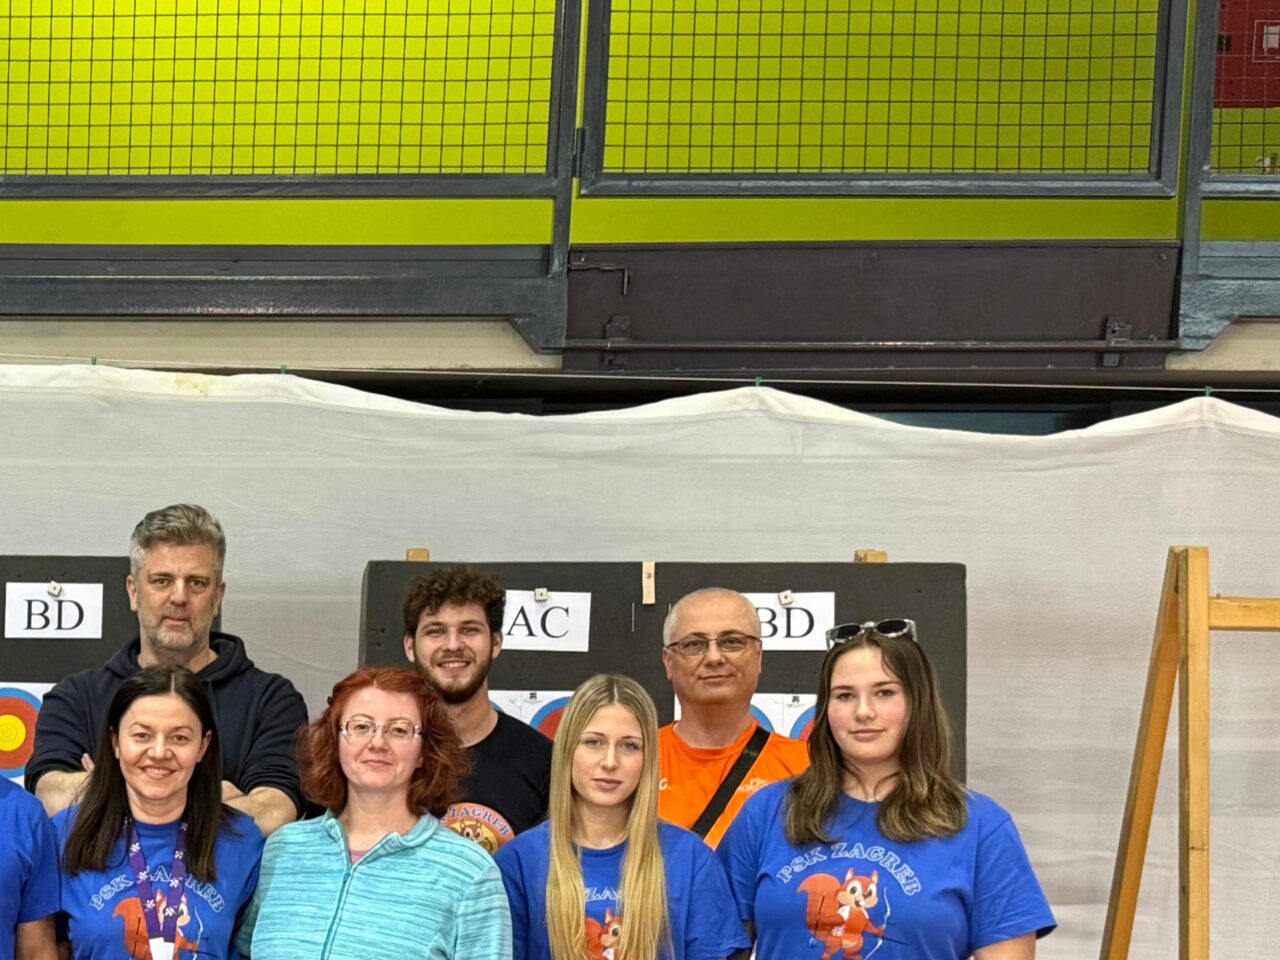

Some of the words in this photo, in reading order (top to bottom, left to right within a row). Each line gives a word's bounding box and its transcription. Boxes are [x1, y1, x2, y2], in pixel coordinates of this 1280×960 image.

[23, 599, 85, 631] BD
[506, 605, 570, 639] AC
[776, 847, 827, 884] PSK
[830, 842, 922, 897] ZAGREB
[89, 874, 133, 911] PSK
